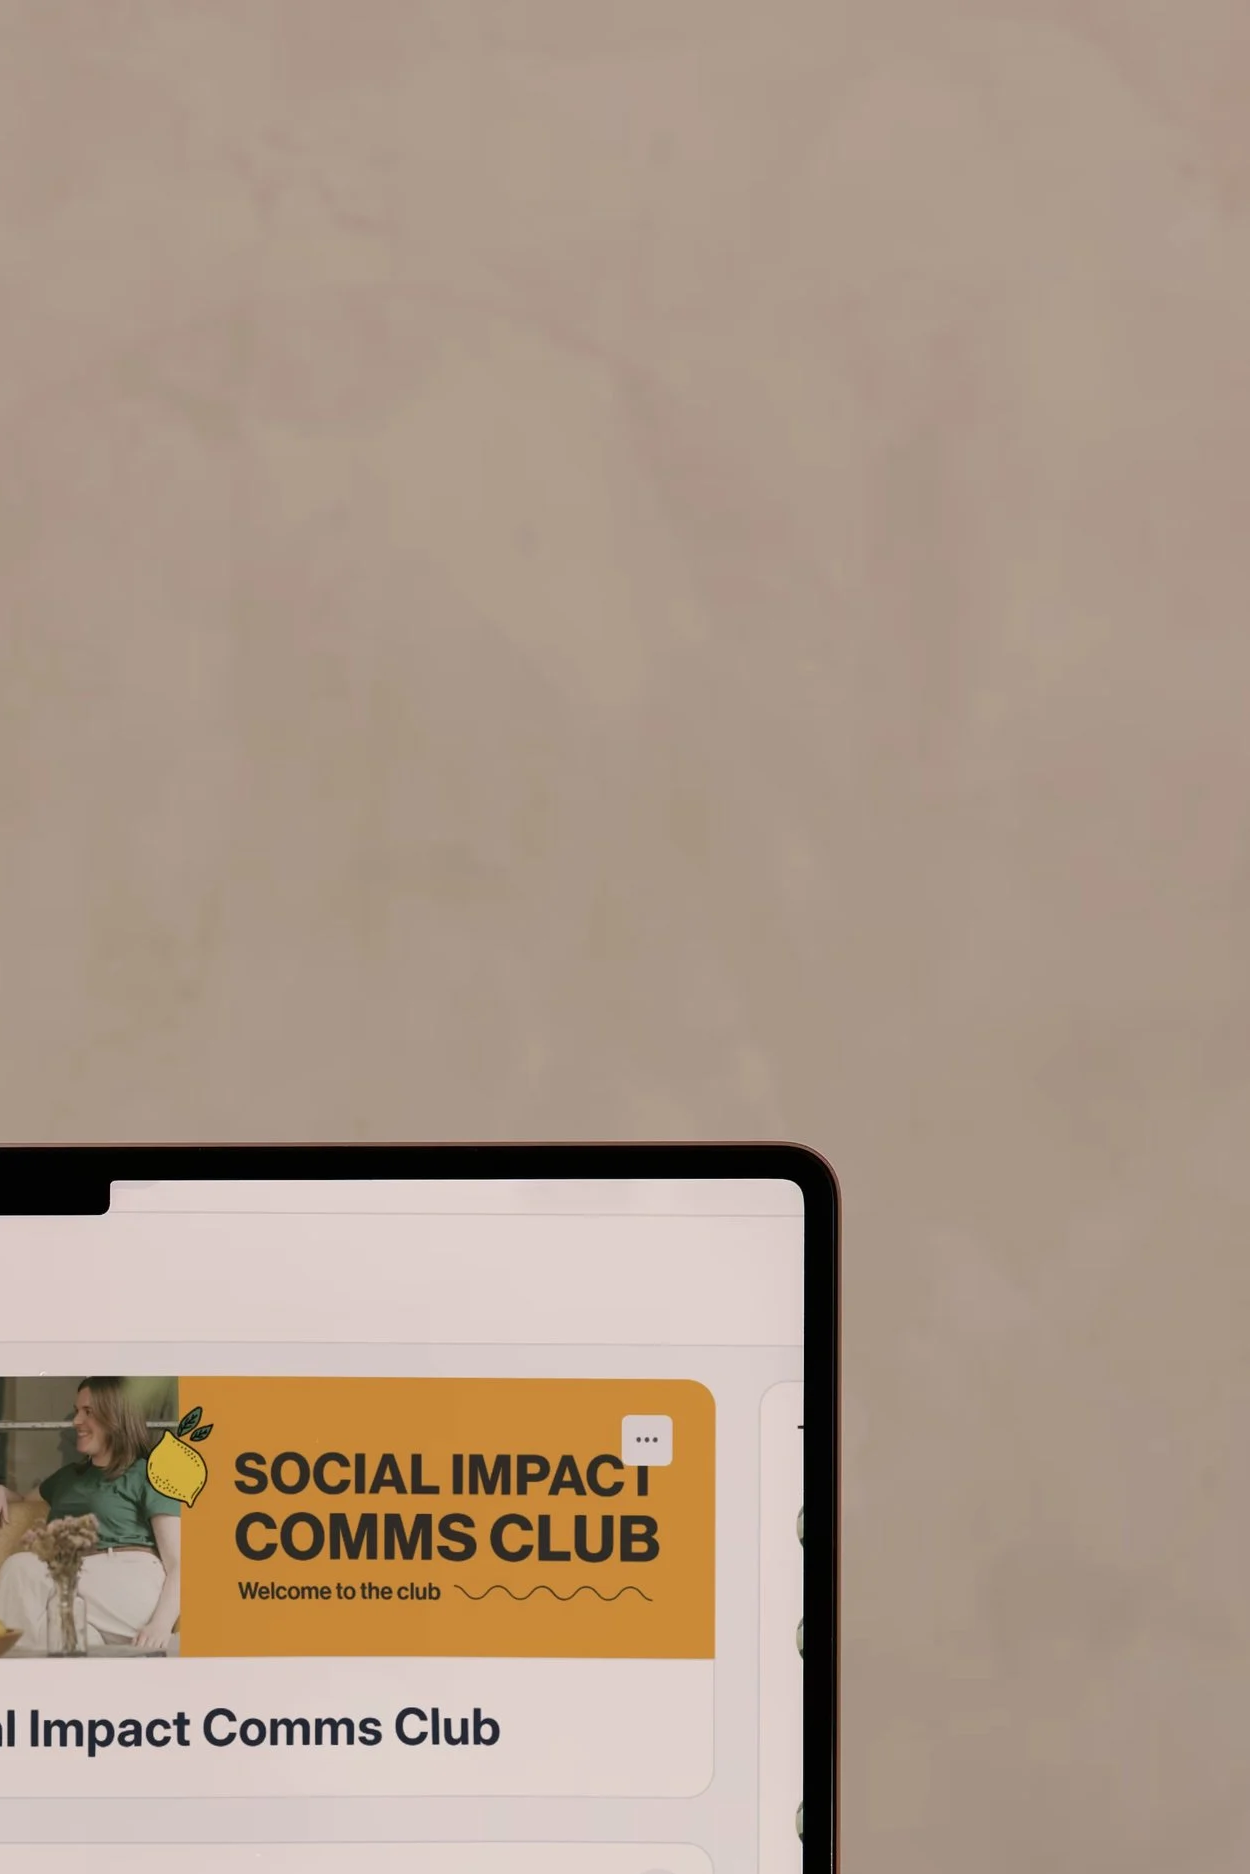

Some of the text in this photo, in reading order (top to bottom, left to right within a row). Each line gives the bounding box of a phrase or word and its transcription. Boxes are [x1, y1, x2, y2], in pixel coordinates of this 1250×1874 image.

[233, 1451, 440, 1496] SOCIAL
[234, 1511, 661, 1564] COMMS CLUB
[237, 1581, 442, 1601] Welcome to the club
[30, 1709, 191, 1758] Impact
[202, 1707, 383, 1748] Comms
[394, 1706, 501, 1747] Club
